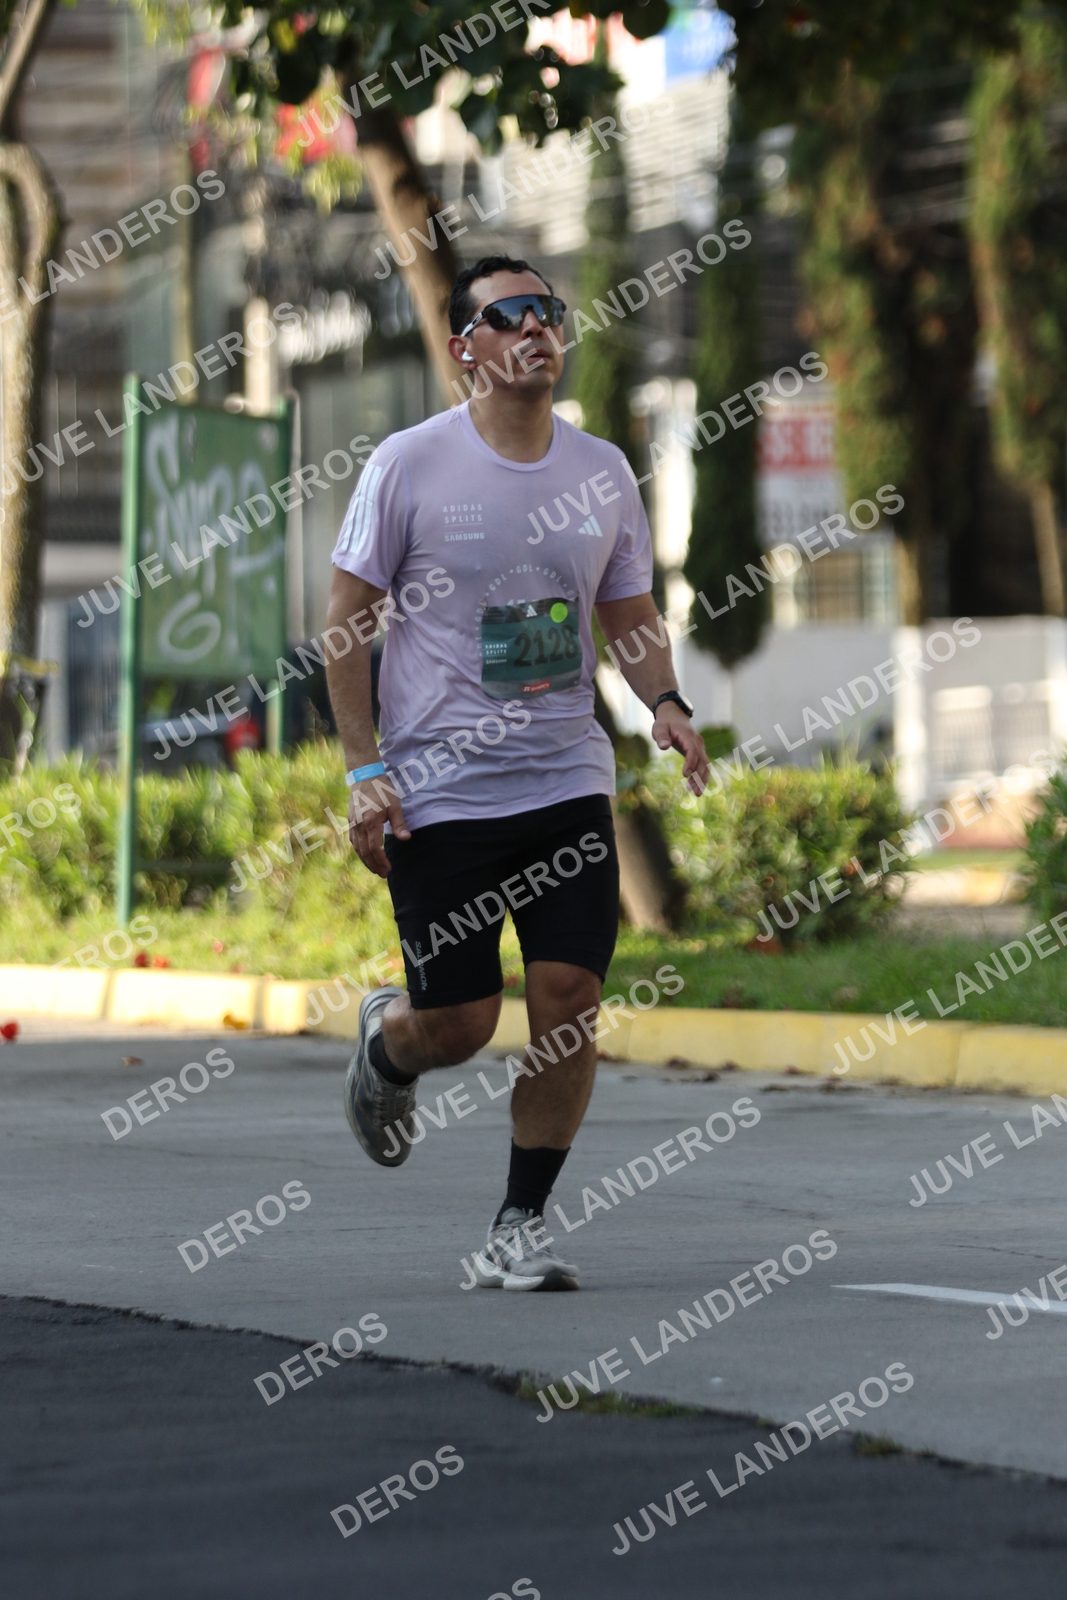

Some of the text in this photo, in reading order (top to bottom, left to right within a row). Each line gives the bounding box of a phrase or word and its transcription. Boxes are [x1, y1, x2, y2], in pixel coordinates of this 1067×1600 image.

[442, 504, 483, 513] ADIDAS
[444, 514, 482, 524] SPLITS
[444, 532, 486, 542] SAMSUNG
[515, 564, 533, 574] GDL
